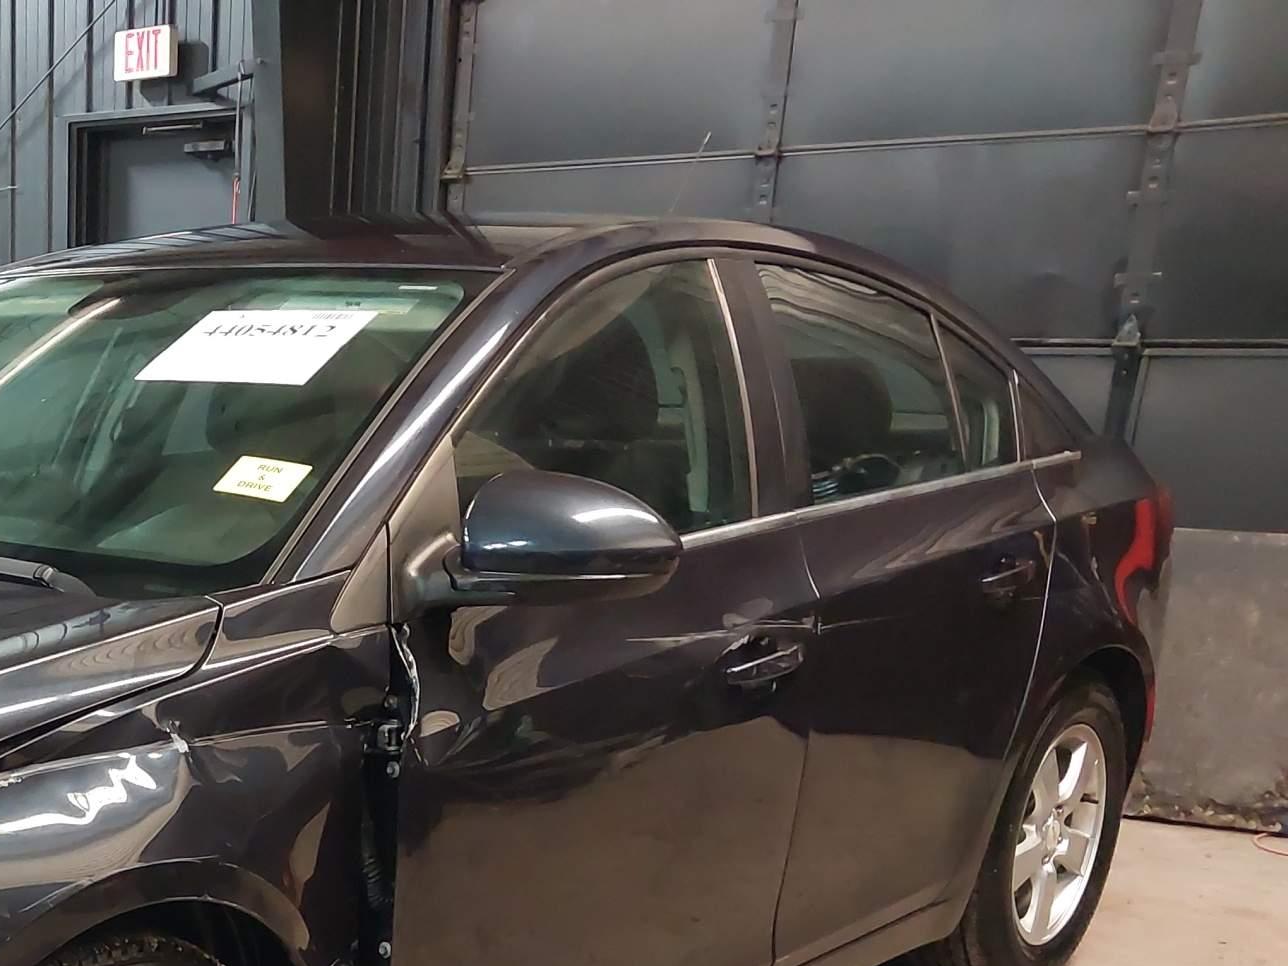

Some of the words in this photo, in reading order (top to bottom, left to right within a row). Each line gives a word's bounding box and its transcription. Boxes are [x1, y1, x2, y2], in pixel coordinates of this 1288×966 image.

[124, 29, 161, 74] EXIT
[203, 324, 336, 337] 44054812
[257, 464, 283, 473] RUN
[236, 480, 272, 492] DRIVE
